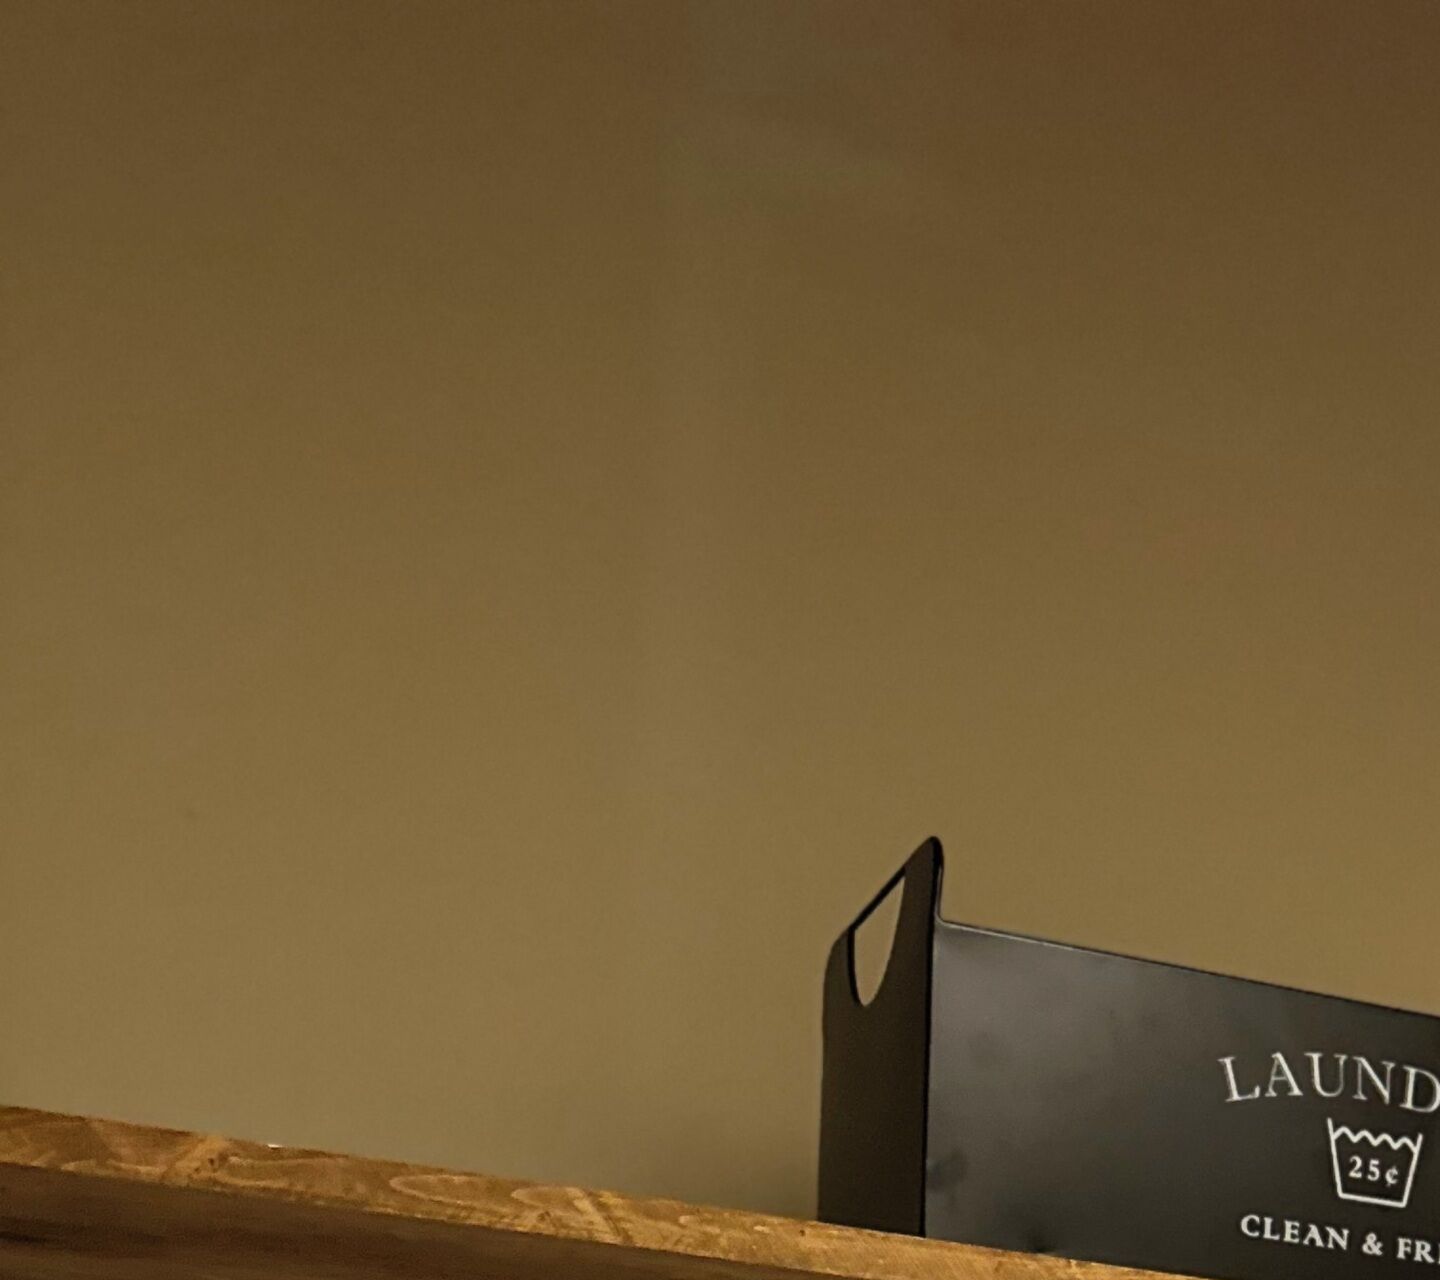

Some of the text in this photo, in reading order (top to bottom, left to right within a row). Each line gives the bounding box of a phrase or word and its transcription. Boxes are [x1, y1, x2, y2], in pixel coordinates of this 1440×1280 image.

[1348, 1156, 1400, 1186] 25¢
[1240, 1214, 1350, 1251] CLEAN
[1361, 1232, 1384, 1257] &
